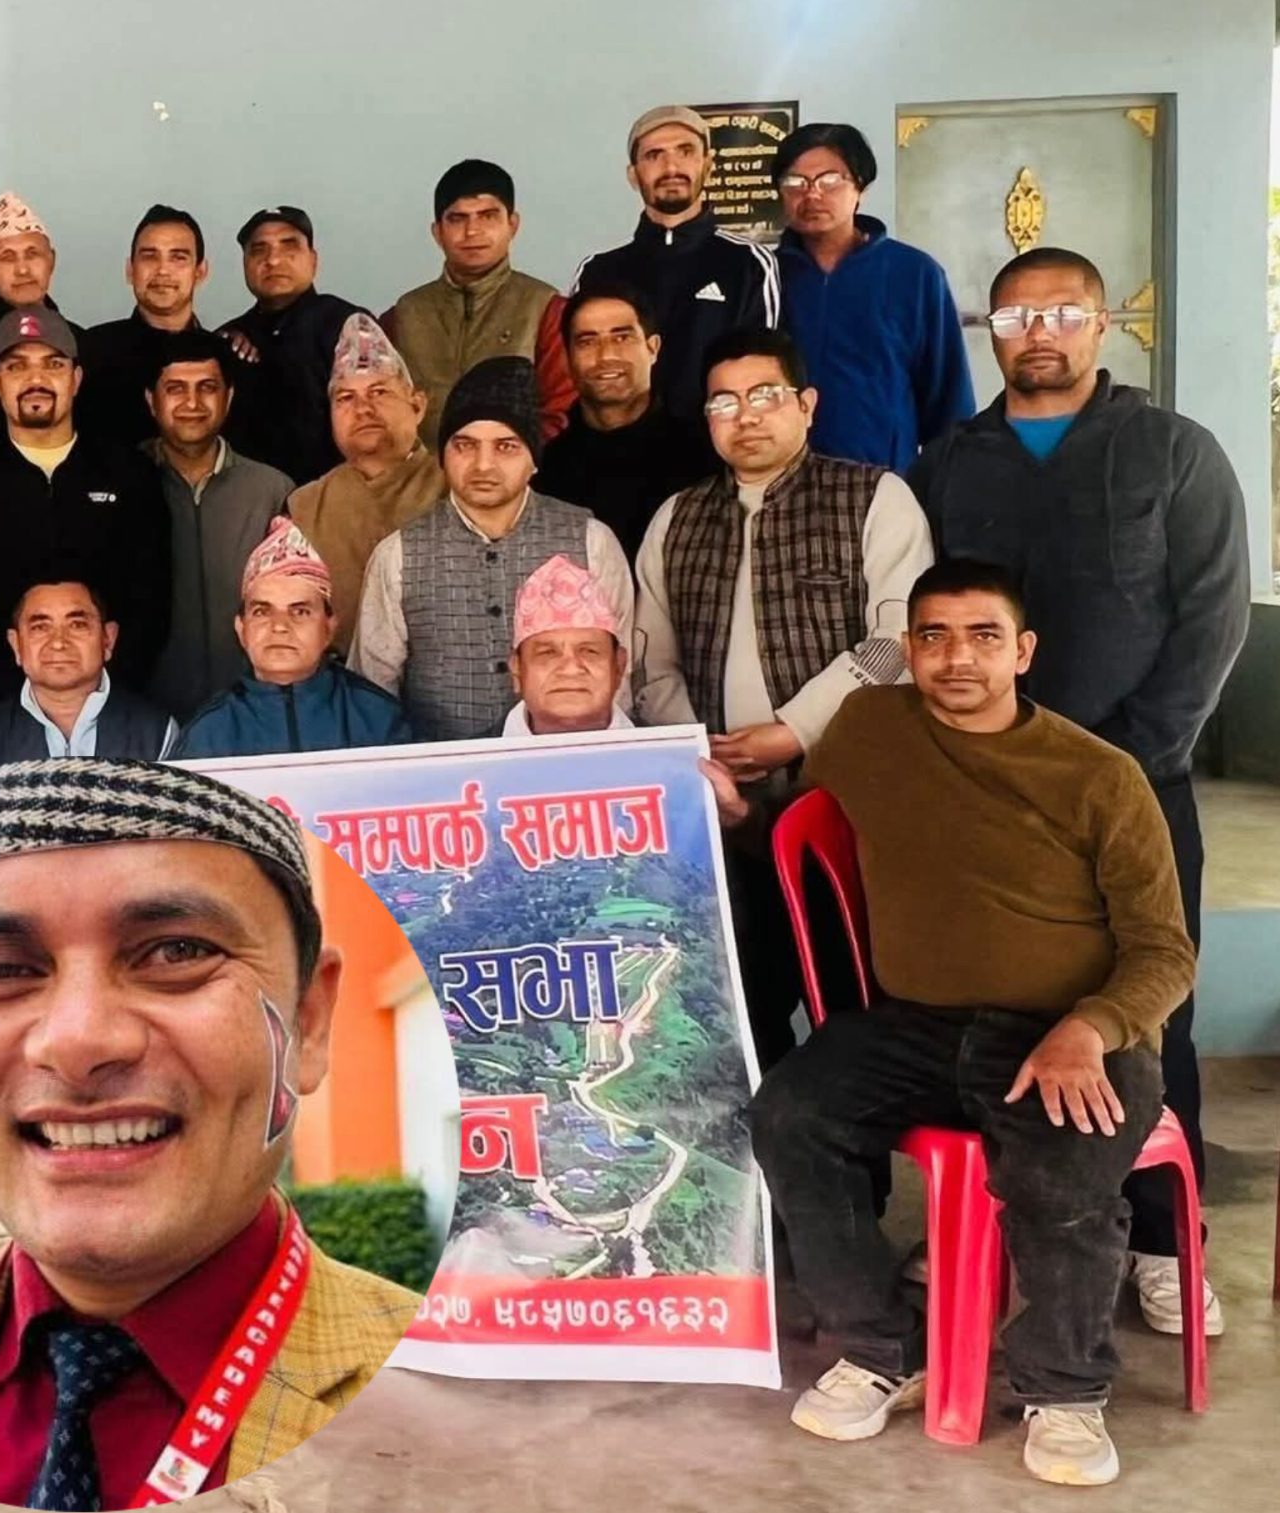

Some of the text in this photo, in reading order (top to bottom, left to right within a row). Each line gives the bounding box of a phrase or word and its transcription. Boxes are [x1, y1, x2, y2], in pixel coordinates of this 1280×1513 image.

[498, 785, 668, 871] समाज
[440, 939, 623, 1034] सभा
[189, 1308, 277, 1449] ACADEMY
